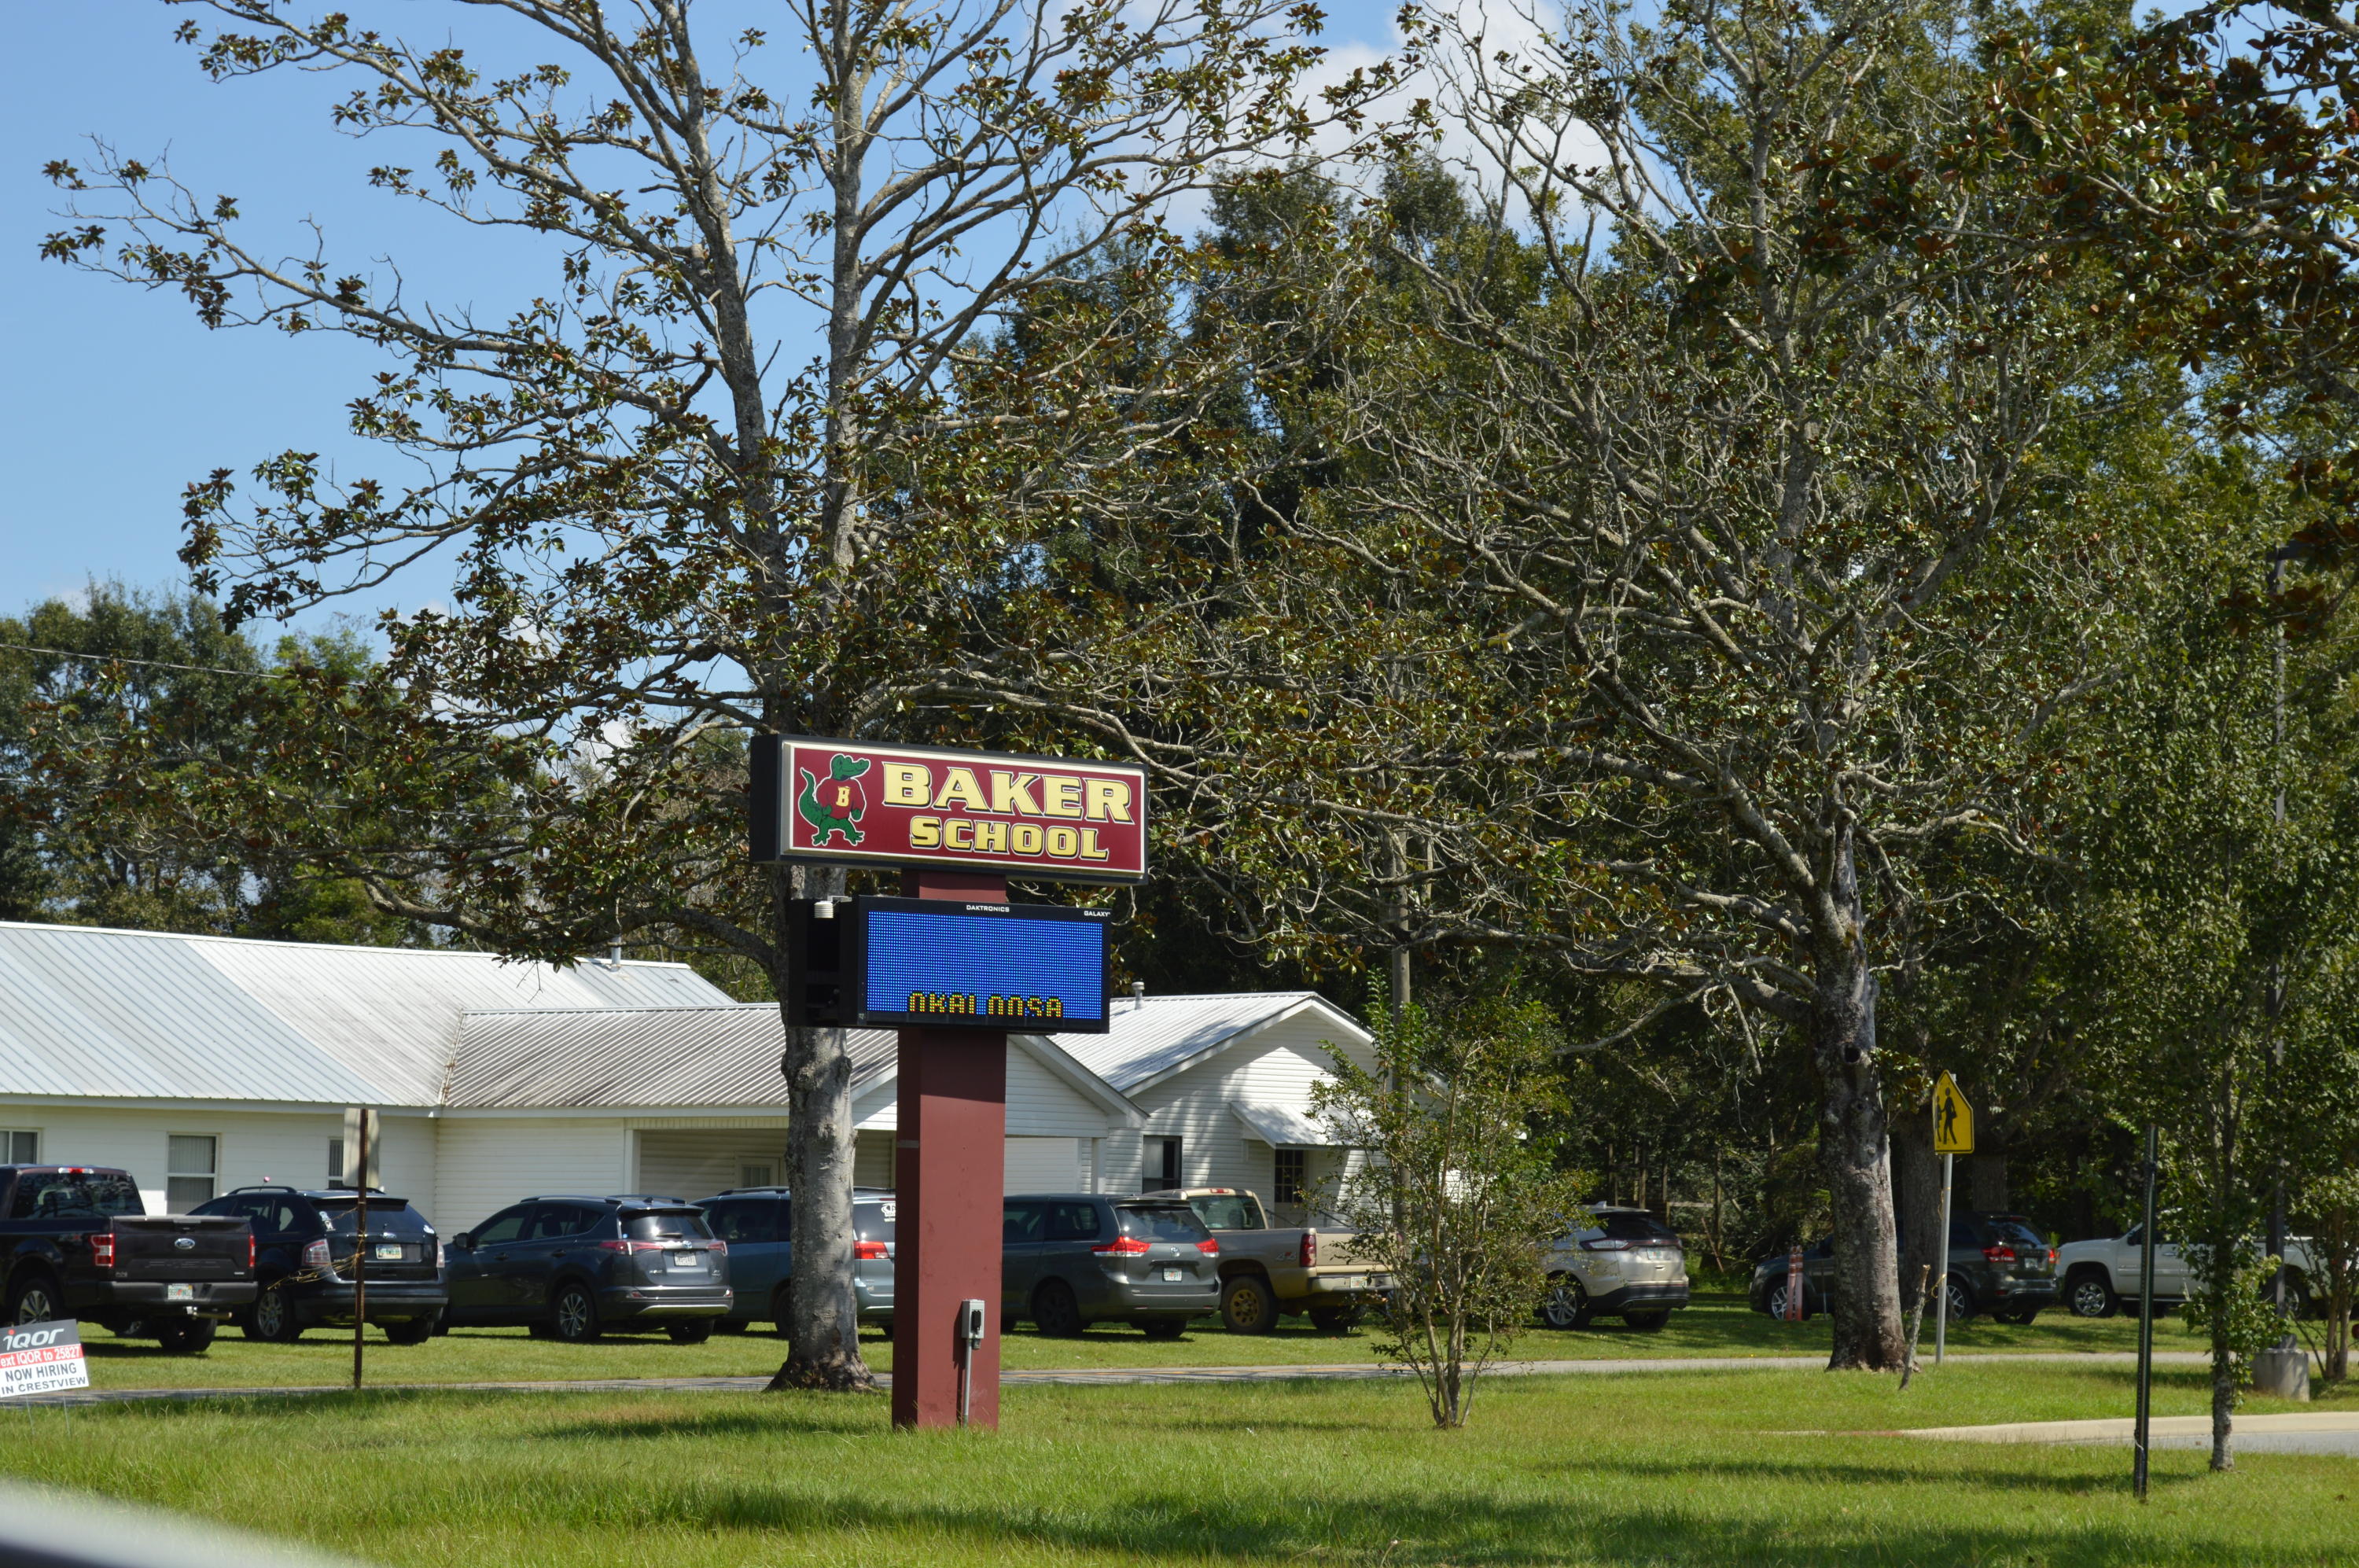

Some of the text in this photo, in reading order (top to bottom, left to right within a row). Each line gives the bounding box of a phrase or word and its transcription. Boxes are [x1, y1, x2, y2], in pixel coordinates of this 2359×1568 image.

[837, 786, 850, 807] B
[882, 762, 1134, 824] BAKER
[910, 816, 1109, 860] SCHOOL
[966, 904, 1010, 913] DAKTRONICS
[0, 1356, 16, 1367] ext
[16, 1351, 42, 1365] IQOR
[43, 1350, 53, 1362] to
[5, 1362, 77, 1382] NOW HIRING
[2, 1376, 86, 1395] IN CRESTVIEW
